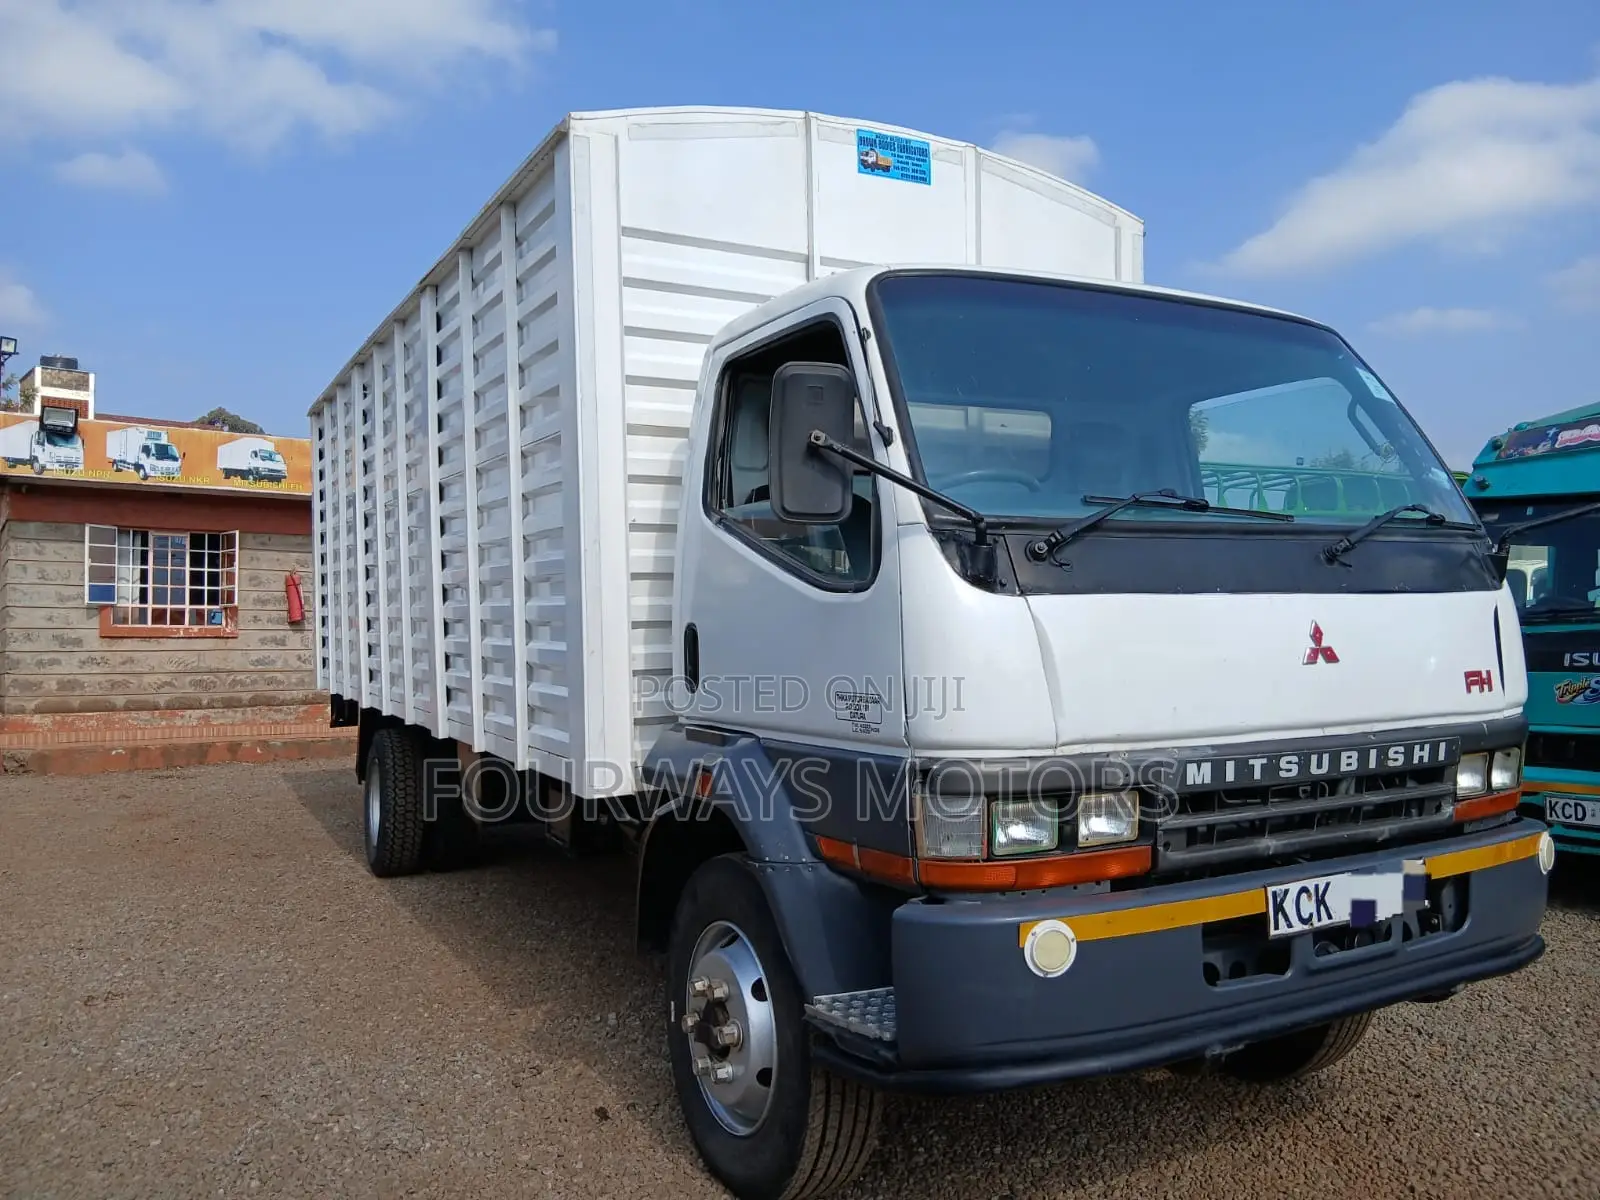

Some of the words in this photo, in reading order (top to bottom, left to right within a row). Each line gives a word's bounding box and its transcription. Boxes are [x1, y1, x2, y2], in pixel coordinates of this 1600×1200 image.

[1464, 669, 1493, 694] FH
[1186, 742, 1446, 785] MITSUBISHI
[1548, 799, 1587, 822] KCD
[1271, 881, 1334, 931] KCK
